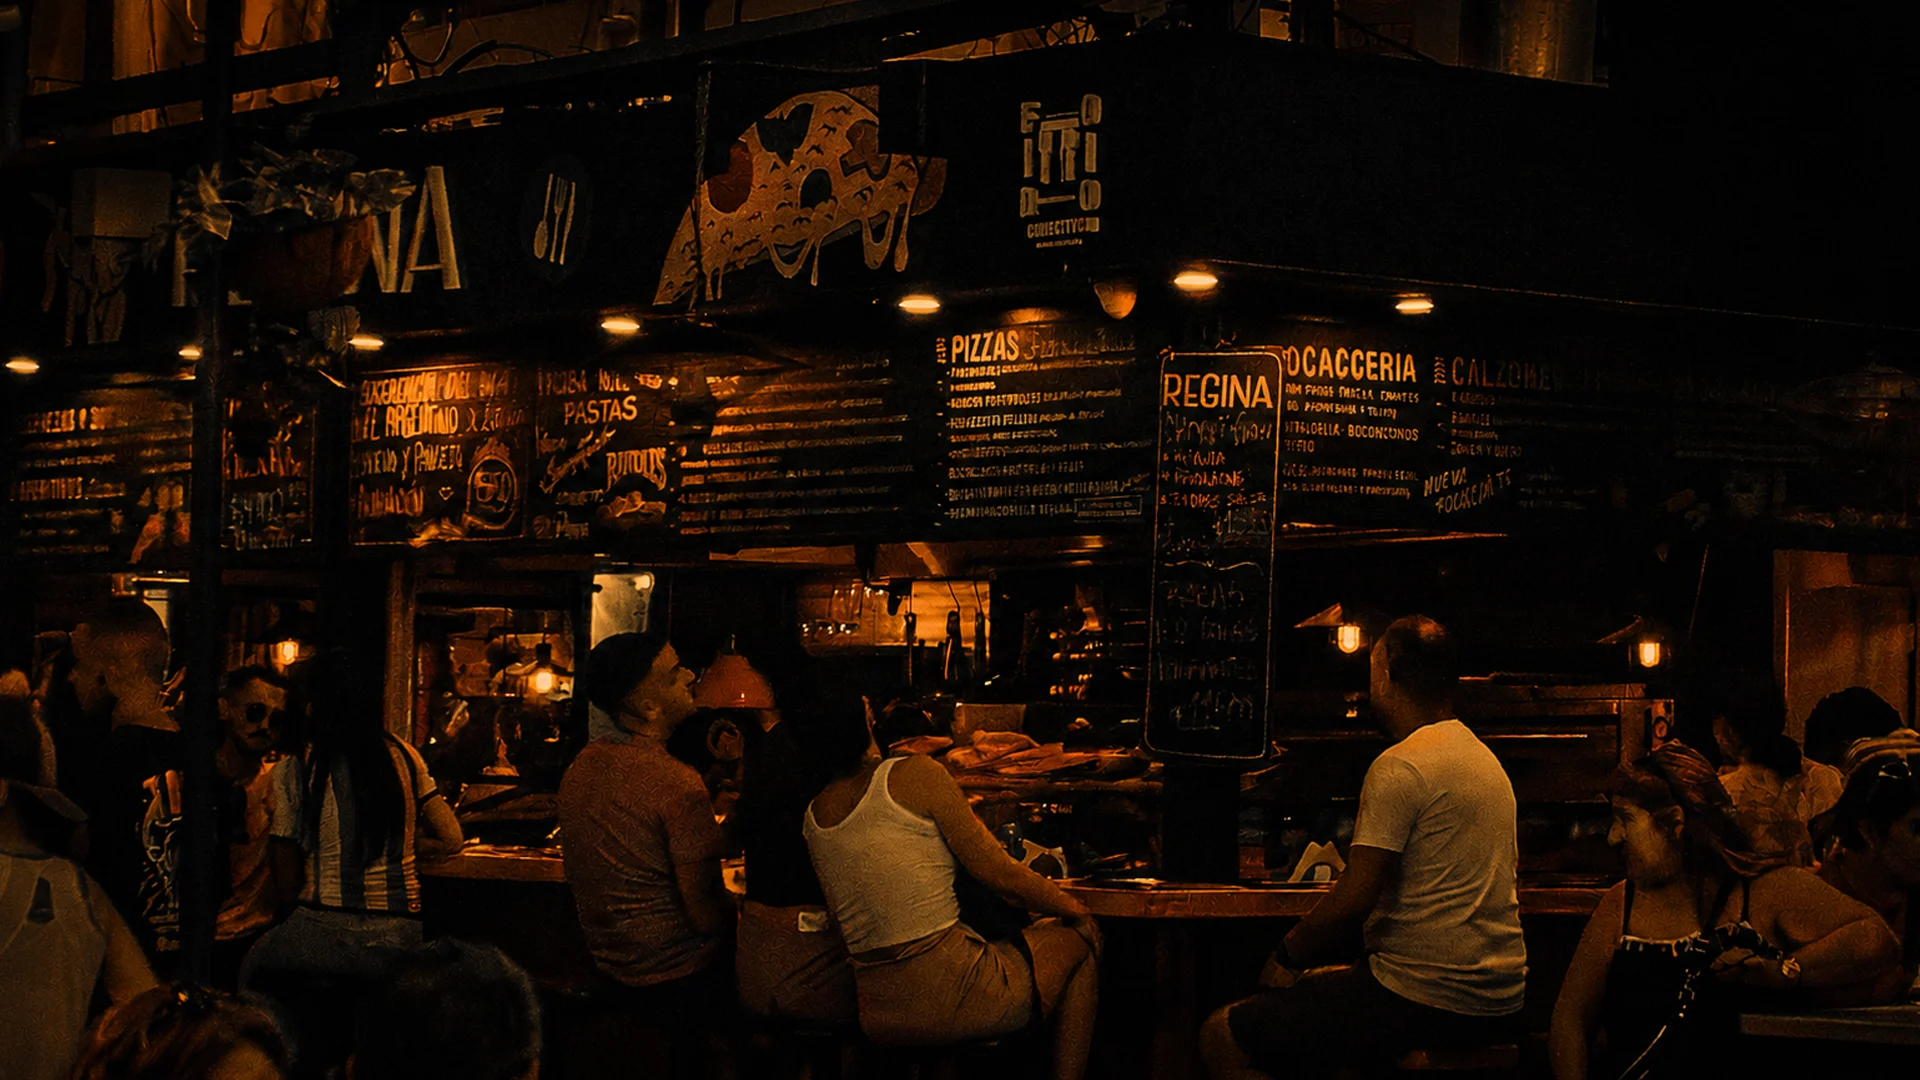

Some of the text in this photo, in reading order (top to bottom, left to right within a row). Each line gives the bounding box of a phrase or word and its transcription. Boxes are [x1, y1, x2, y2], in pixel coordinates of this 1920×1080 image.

[951, 330, 1020, 364] PIZZAS
[1283, 345, 1418, 383] OCACCERIA
[1162, 373, 1274, 408] REGINA
[563, 394, 638, 426] PASTAS
